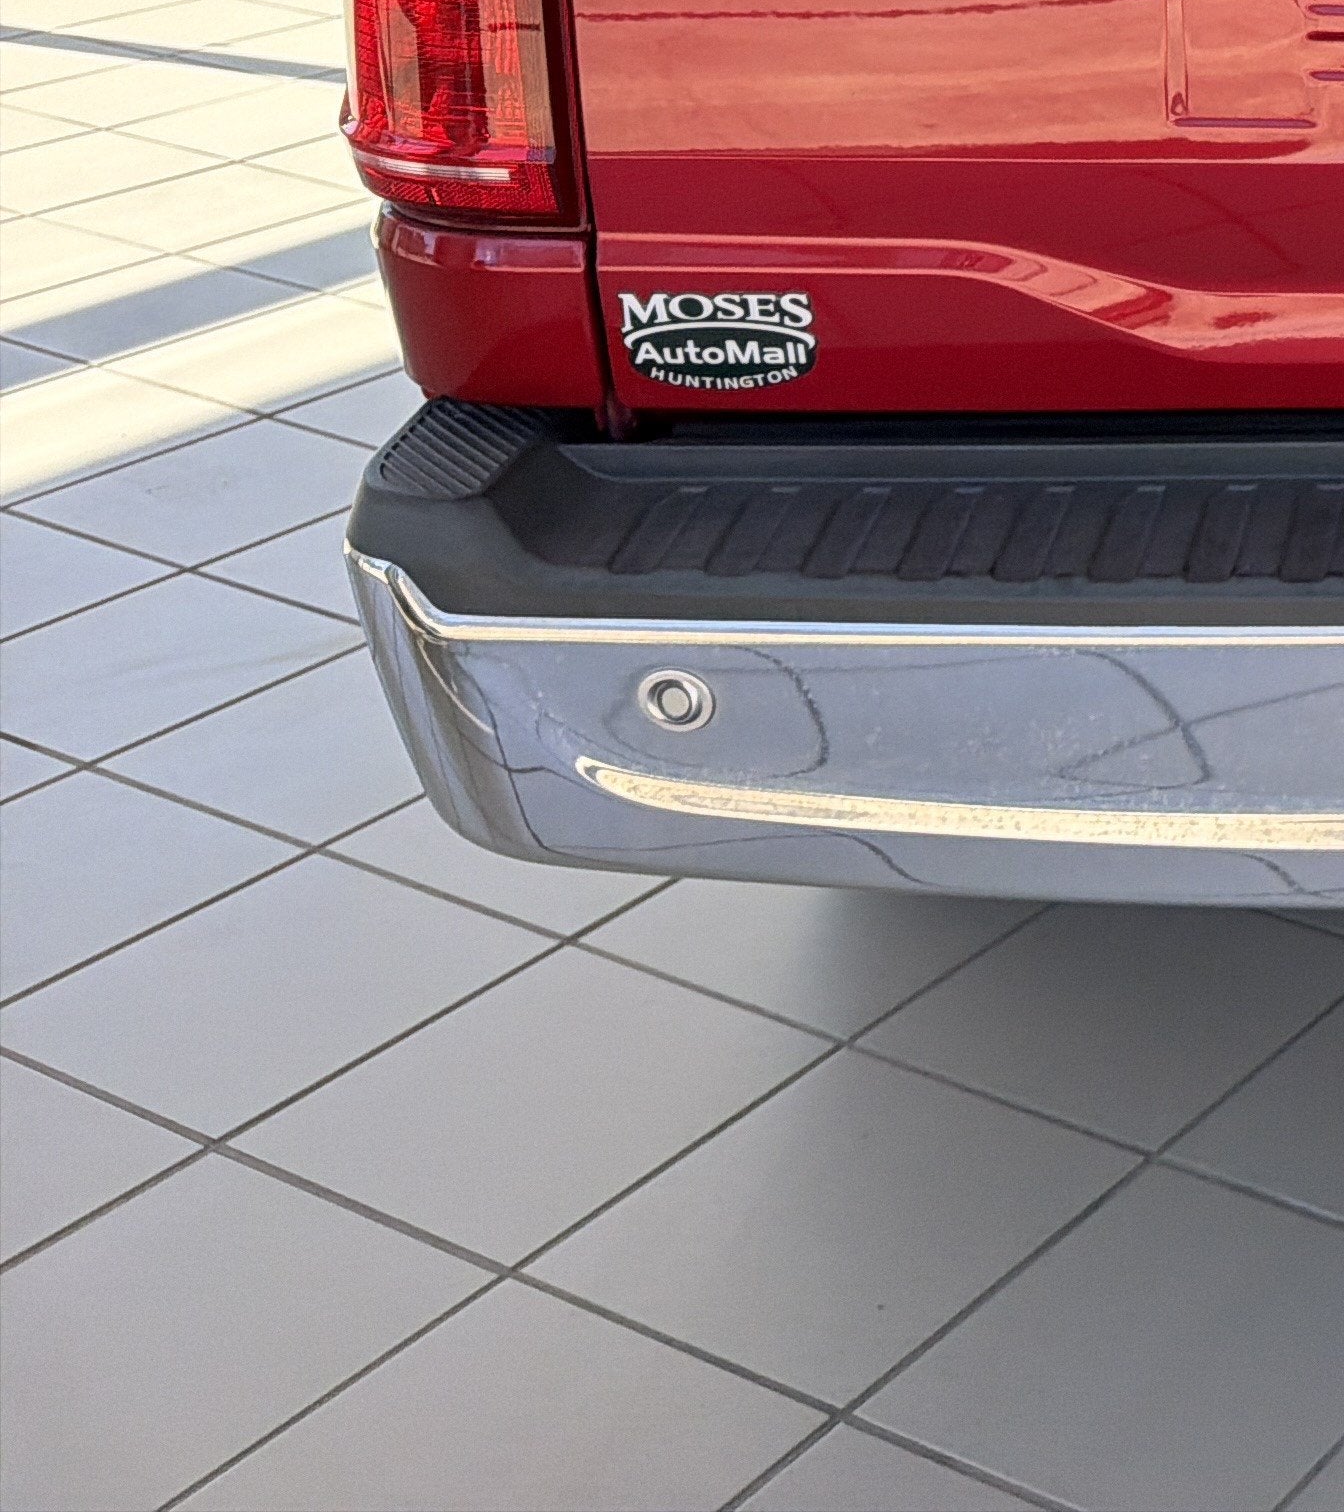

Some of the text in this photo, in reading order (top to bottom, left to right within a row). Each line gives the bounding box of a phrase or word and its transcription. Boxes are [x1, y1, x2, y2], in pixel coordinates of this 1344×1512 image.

[617, 293, 813, 333] MOSES
[634, 339, 807, 364] AutoMall
[650, 366, 799, 389] HUNTINGTON
